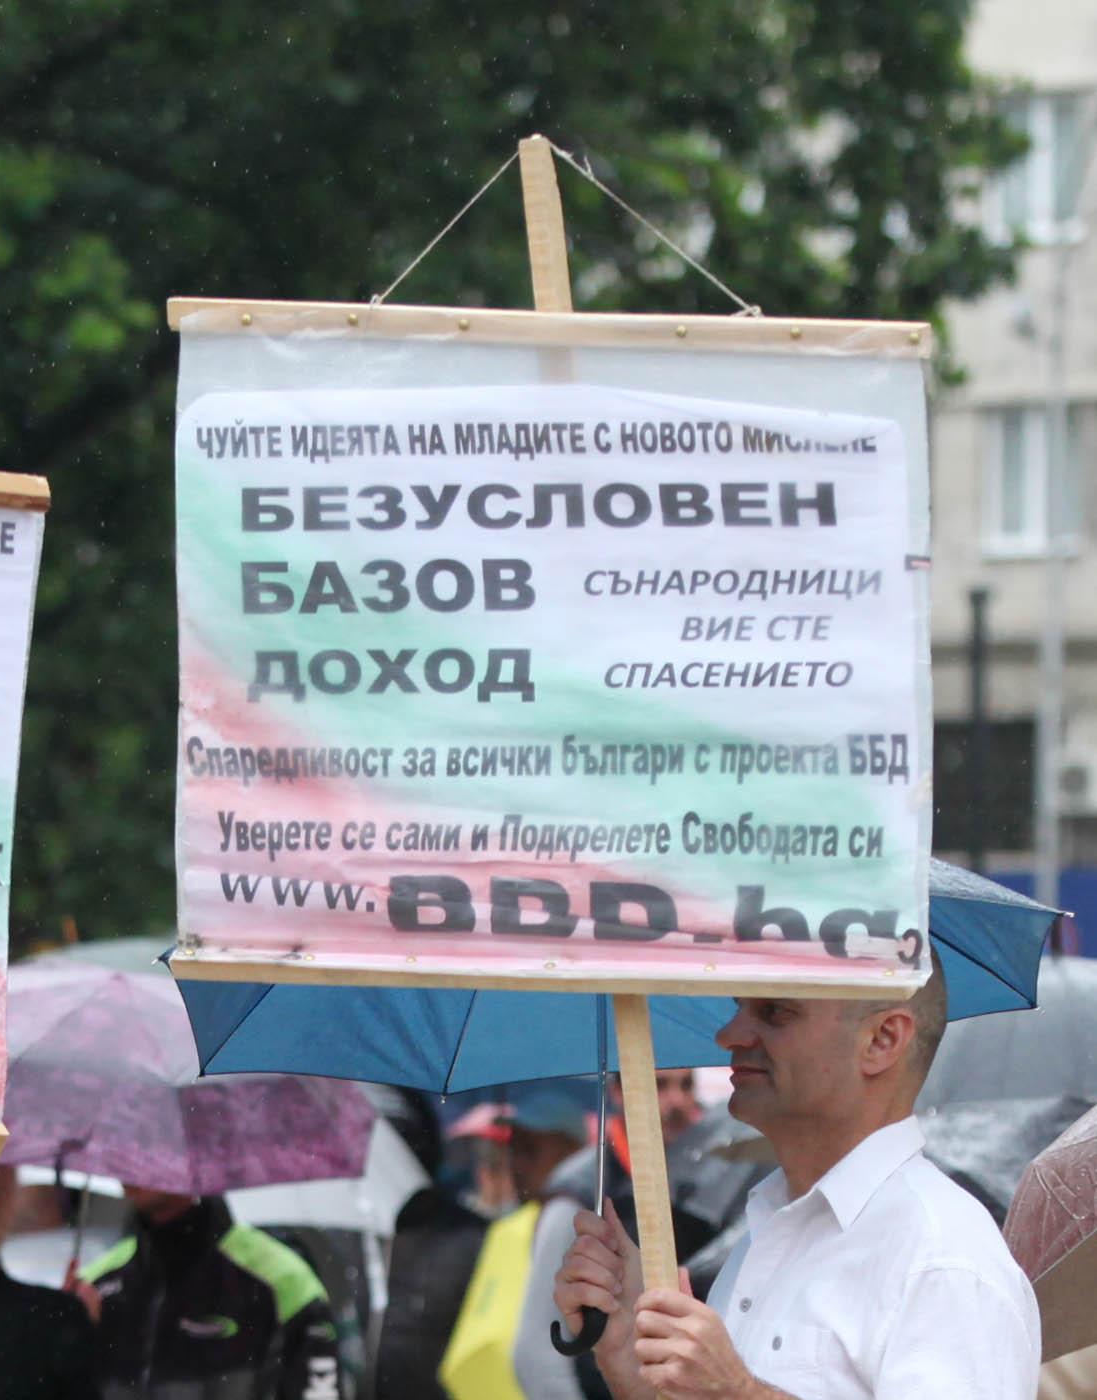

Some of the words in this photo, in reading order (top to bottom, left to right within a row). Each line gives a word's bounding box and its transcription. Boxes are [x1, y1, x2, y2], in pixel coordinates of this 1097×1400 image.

[196, 419, 282, 458] ЧУЙТЕ
[291, 425, 399, 463] ИДЕЯТА
[408, 424, 447, 455] НА
[454, 422, 586, 461] МЛАДИТЕ
[594, 421, 612, 454] С
[622, 421, 732, 454] НОВОТО
[241, 482, 838, 533] БЕЗУСЛОВЕН
[241, 558, 537, 616] БАЗОВ
[584, 569, 883, 600] СЪНАРОДНИЦИ
[681, 616, 755, 642] ВИЕ
[766, 616, 832, 642] СТЕ
[247, 648, 536, 704] ДОХОД
[604, 661, 853, 689] СПАСЕНИЕТО
[187, 736, 393, 786] Спаредливост
[403, 747, 436, 777] за
[447, 745, 551, 777] всички
[562, 735, 684, 785] българи
[694, 744, 710, 774] с
[720, 743, 839, 785] проекта
[848, 734, 909, 785] ББД
[218, 811, 332, 861] Уверете
[342, 820, 376, 850] се
[385, 821, 461, 851] сами
[471, 823, 489, 851] и
[499, 814, 671, 861] Подкрепете
[682, 811, 839, 864] Свободата
[848, 826, 884, 858] си
